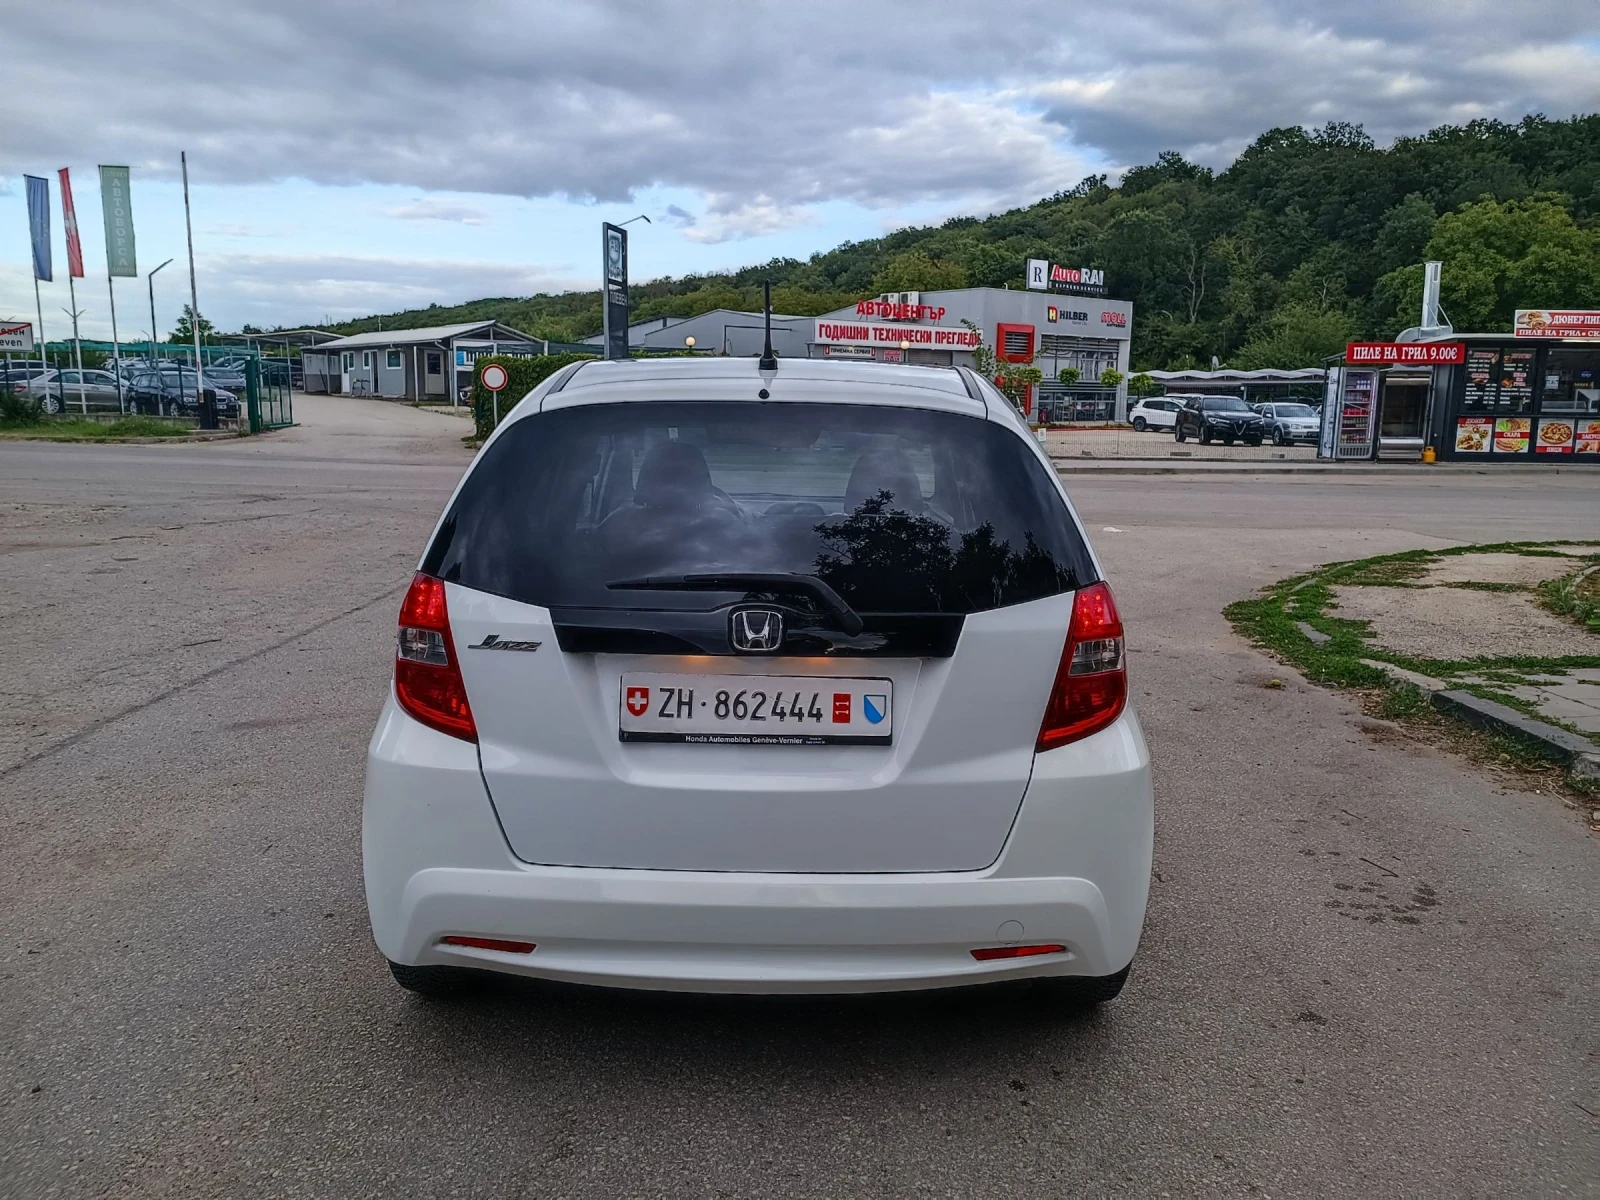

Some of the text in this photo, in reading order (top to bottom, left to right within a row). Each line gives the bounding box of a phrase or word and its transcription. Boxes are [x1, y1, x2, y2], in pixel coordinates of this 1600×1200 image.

[1033, 266, 1042, 283] R
[856, 300, 946, 321] АВТОЦЕНТЪР
[1059, 310, 1088, 321] HILBER
[1552, 315, 1584, 325] ДЮНЕР
[819, 323, 869, 341] ГОДИШНИ
[872, 327, 932, 344] ТЕХНИЧЕСКИ
[1353, 347, 1382, 360] ПИЛЕ
[1384, 347, 1398, 360] НА
[1401, 347, 1428, 360] ГРИЛ
[1430, 347, 1458, 360] 9.00€
[467, 634, 542, 652] Jazz
[658, 687, 694, 719] ZH
[714, 689, 824, 723] 862444
[685, 735, 708, 743] Honda
[709, 736, 751, 744] Automobiles
